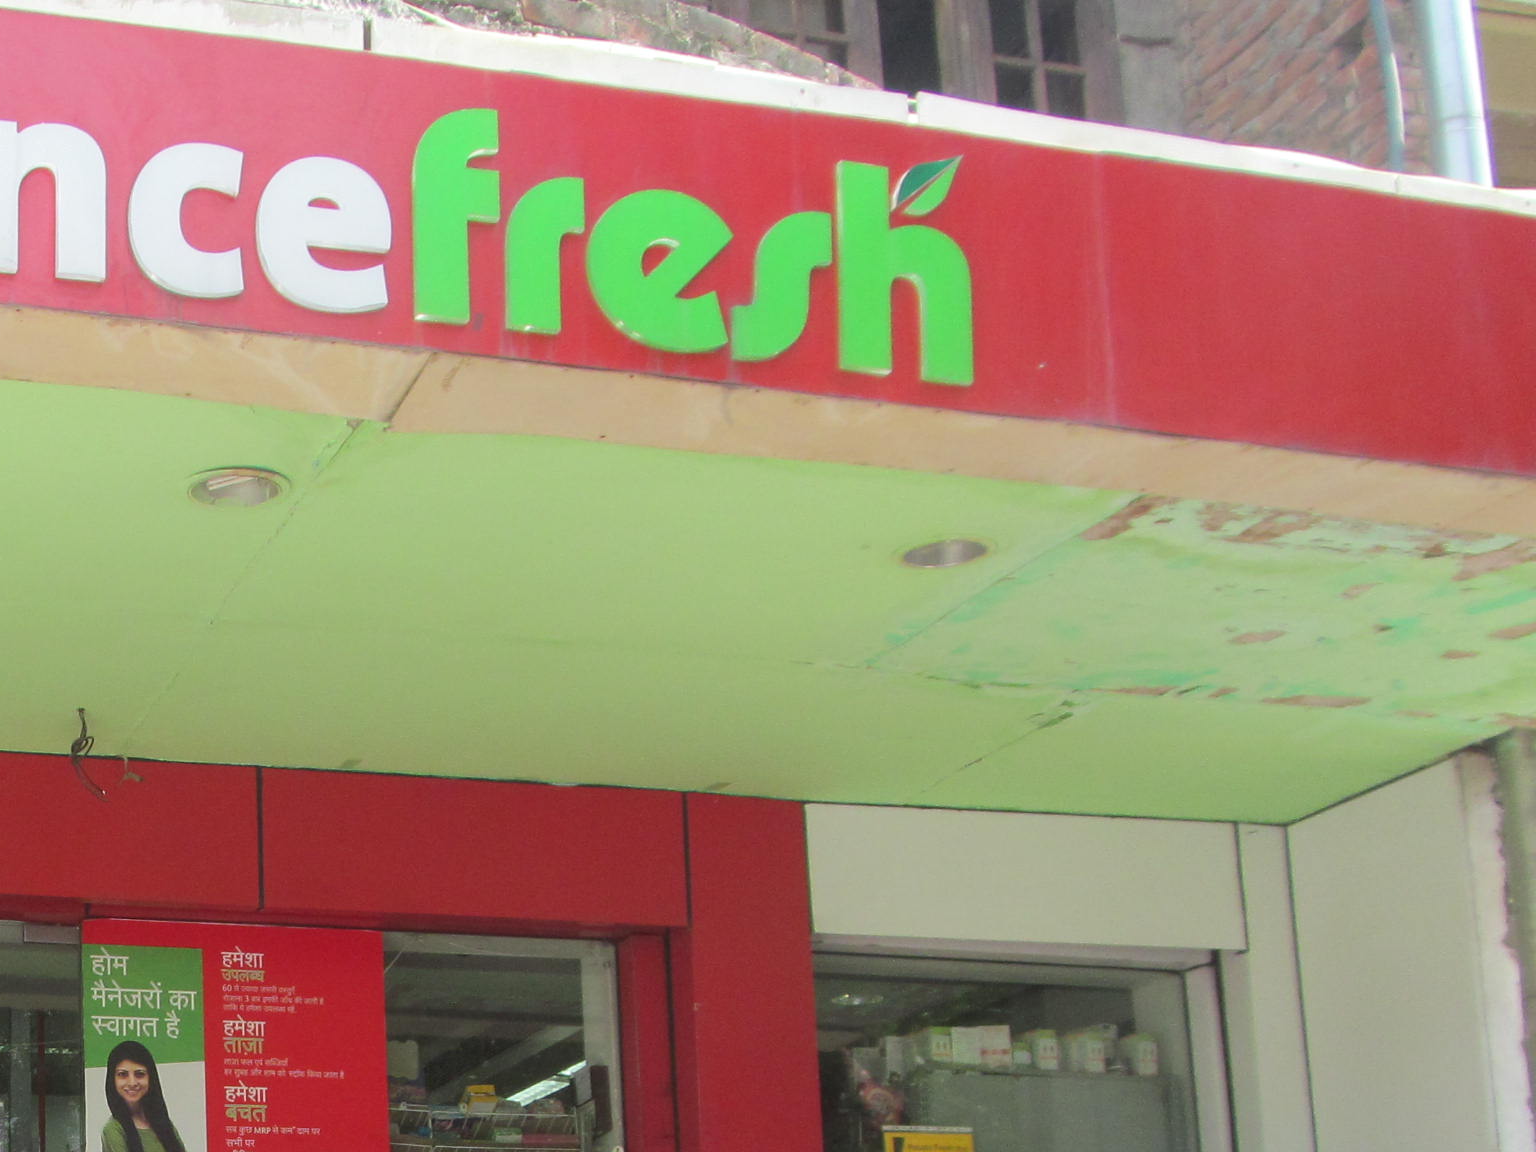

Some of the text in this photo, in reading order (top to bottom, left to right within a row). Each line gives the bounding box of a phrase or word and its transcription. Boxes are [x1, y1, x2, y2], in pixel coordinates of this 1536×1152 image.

[90, 946, 129, 976] होम
[221, 945, 265, 969] हमेशा
[90, 979, 197, 1011] मैनेजरों का
[90, 1010, 181, 1039] स्वागत है
[223, 1014, 266, 1037] हमेशा
[223, 1036, 265, 1056] ताज़ा
[224, 1080, 268, 1103] हमेशा
[224, 1104, 268, 1123] बचत
[254, 1127, 271, 1135] MRP
